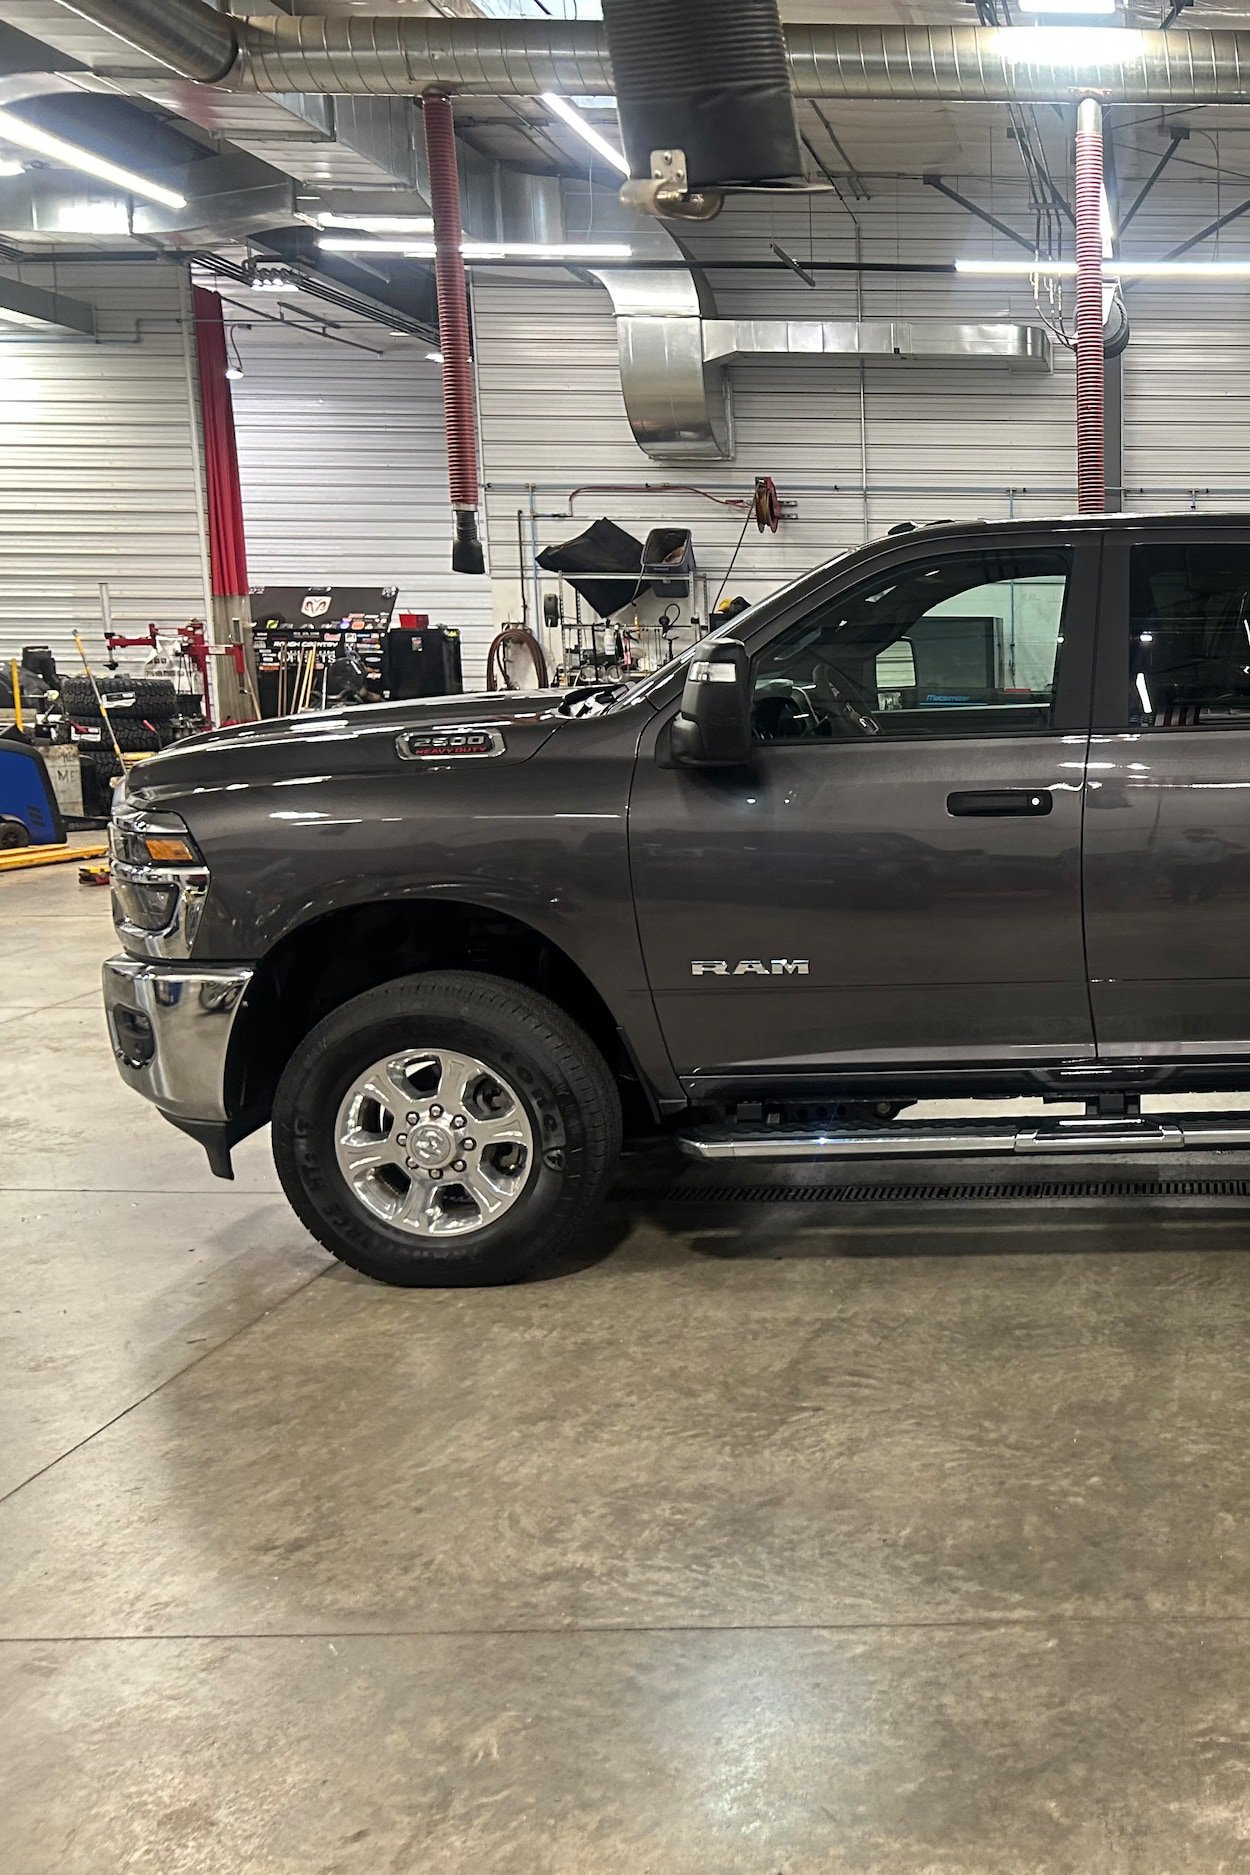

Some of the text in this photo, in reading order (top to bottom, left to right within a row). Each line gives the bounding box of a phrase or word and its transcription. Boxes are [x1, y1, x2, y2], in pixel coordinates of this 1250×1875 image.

[413, 735, 485, 747] 2500
[415, 745, 488, 755] HEAVY DUTY
[691, 959, 810, 976] RAM
